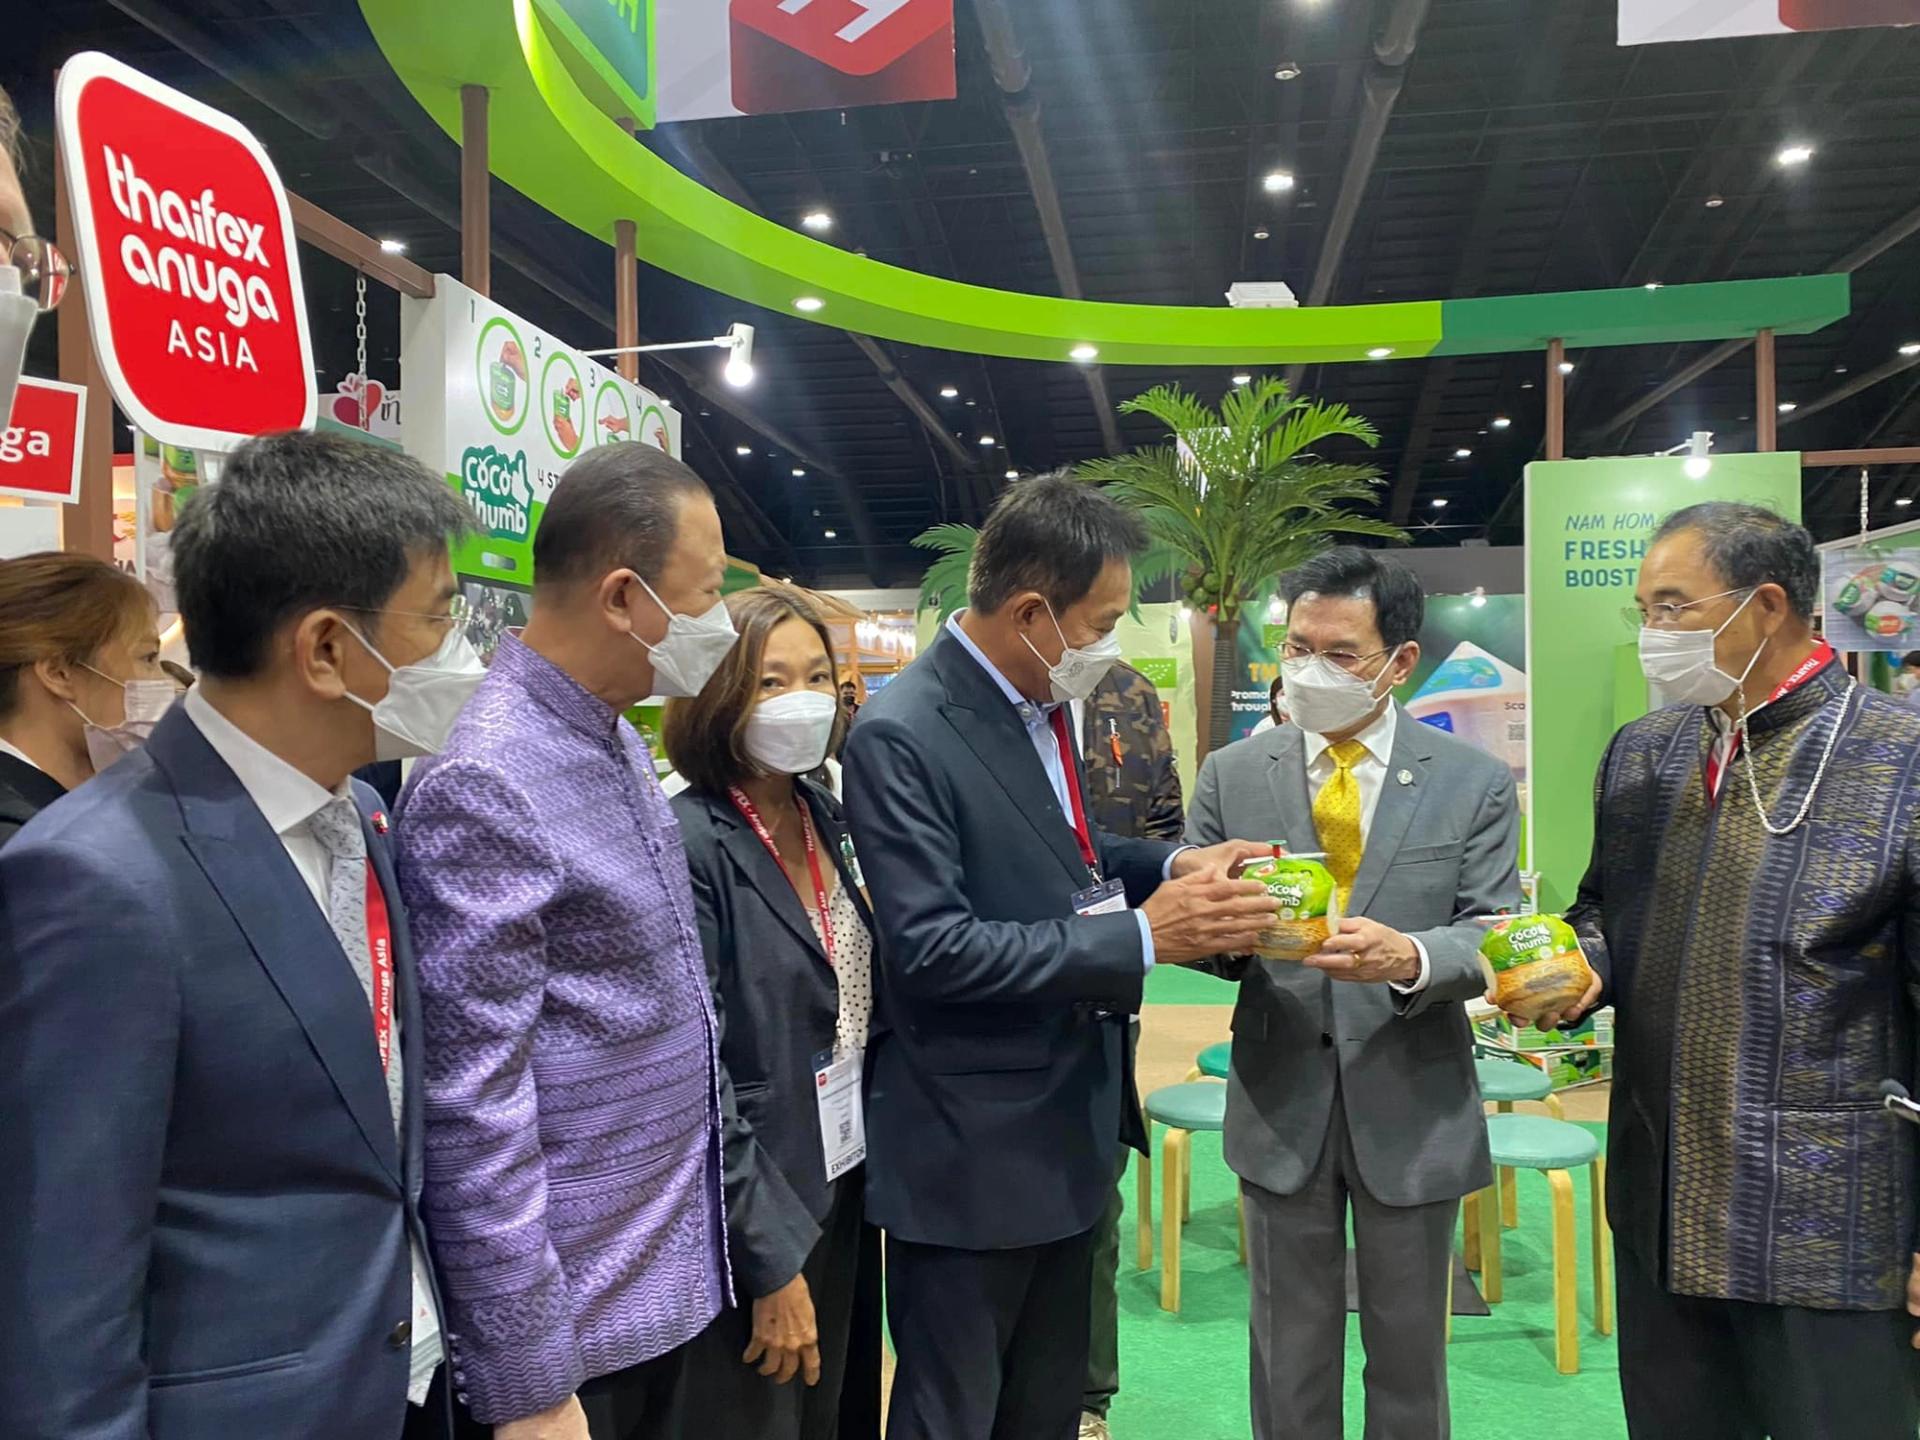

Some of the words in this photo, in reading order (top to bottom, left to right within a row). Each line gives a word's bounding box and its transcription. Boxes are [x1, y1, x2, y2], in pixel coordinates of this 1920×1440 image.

[103, 144, 270, 268] thaifex
[120, 234, 279, 328] anuga
[470, 299, 476, 323] 1
[167, 319, 259, 373] ASIA
[533, 336, 542, 359] 2
[590, 367, 597, 388] 3
[636, 395, 643, 415] 4
[465, 489, 528, 535] Thumb
[1564, 514, 1605, 531] NAM
[1612, 512, 1655, 530] HOM
[1564, 540, 1648, 560] FRESH
[1565, 568, 1637, 588] BOOST
[375, 938, 388, 968] Asia
[380, 970, 391, 1015] Anuga
